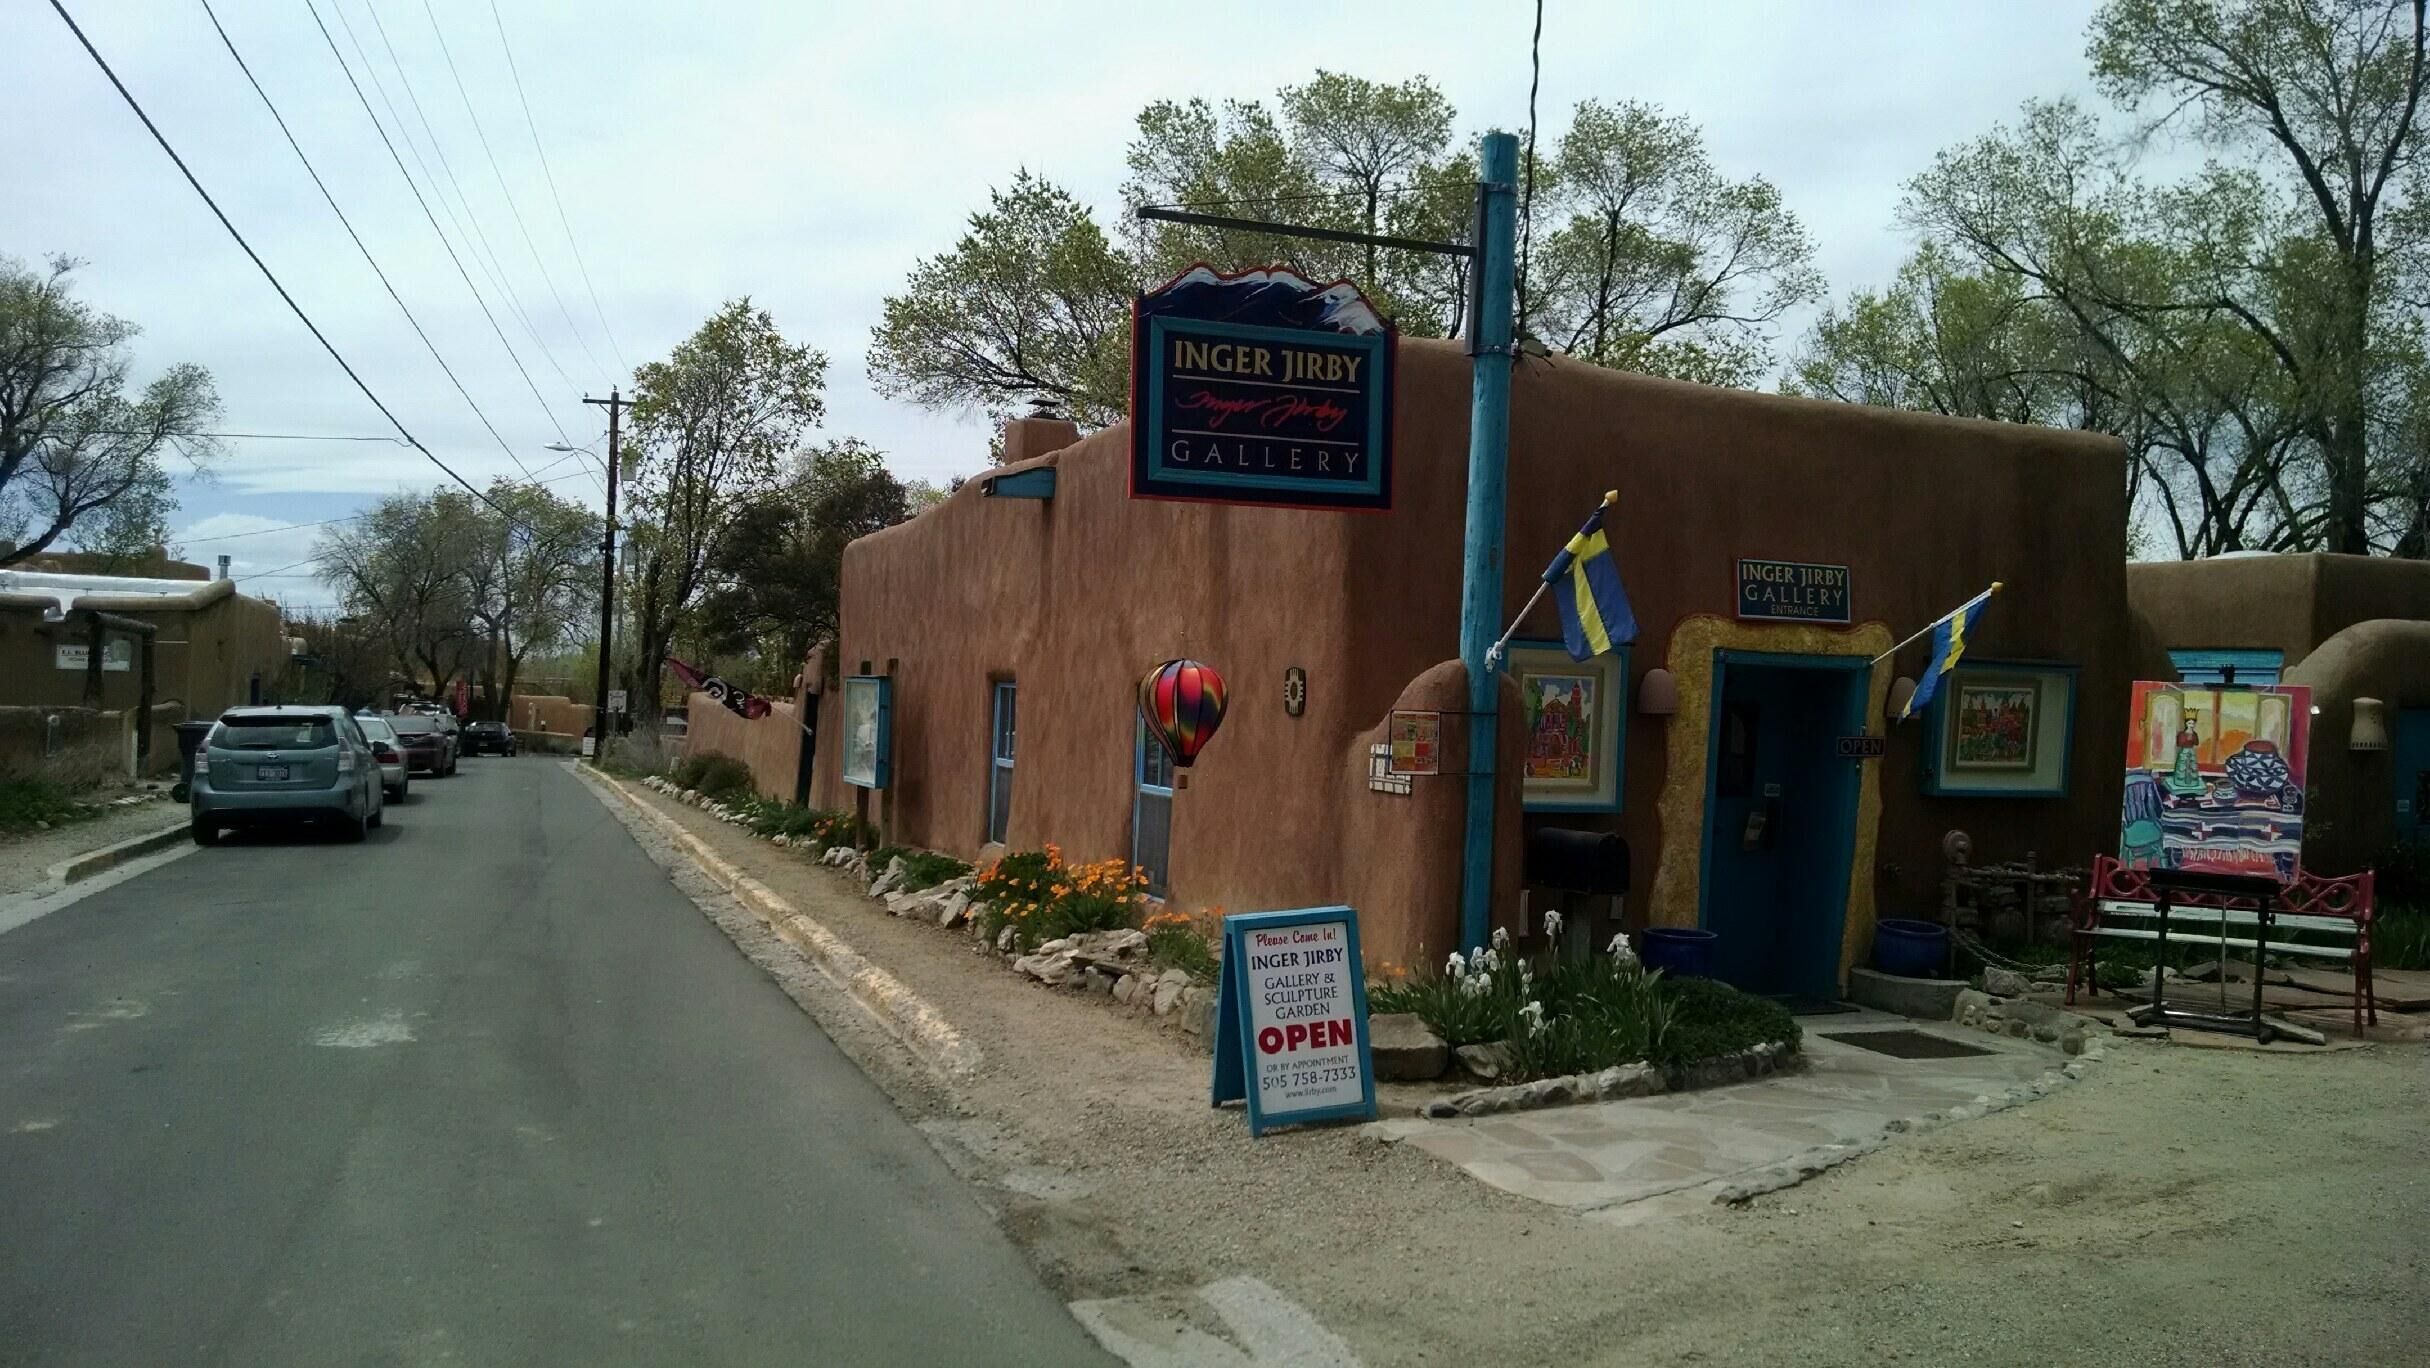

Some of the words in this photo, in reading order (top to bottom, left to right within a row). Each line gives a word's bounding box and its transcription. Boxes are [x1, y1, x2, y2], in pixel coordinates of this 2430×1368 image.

[1174, 340, 1272, 377] INGER
[1281, 350, 1362, 383] JIRBY
[1171, 440, 1359, 473] GALLERY
[1742, 564, 1795, 583] INGER
[1800, 568, 1845, 587] JIRBY
[1745, 584, 1843, 606] GALLERY
[1771, 604, 1819, 616] ENTRANCE
[1840, 739, 1880, 754] OPEN
[1255, 931, 1288, 947] Please
[1293, 930, 1319, 944] Come
[1323, 928, 1337, 942] In!
[1251, 951, 1299, 971] INGER
[1303, 948, 1344, 968] JIRBY
[1264, 973, 1320, 990] GALLERY
[1324, 973, 1335, 985] &
[1264, 986, 1338, 1005] SCULPTURE
[1275, 1002, 1330, 1020] GARDEN
[1258, 1018, 1353, 1055] OPEN
[1266, 1064, 1278, 1073] OR
[1281, 1063, 1290, 1071] BY
[1292, 1055, 1348, 1071] APPOINTMENT
[1263, 1074, 1287, 1091] 505
[1292, 1066, 1356, 1087] 758-7333
